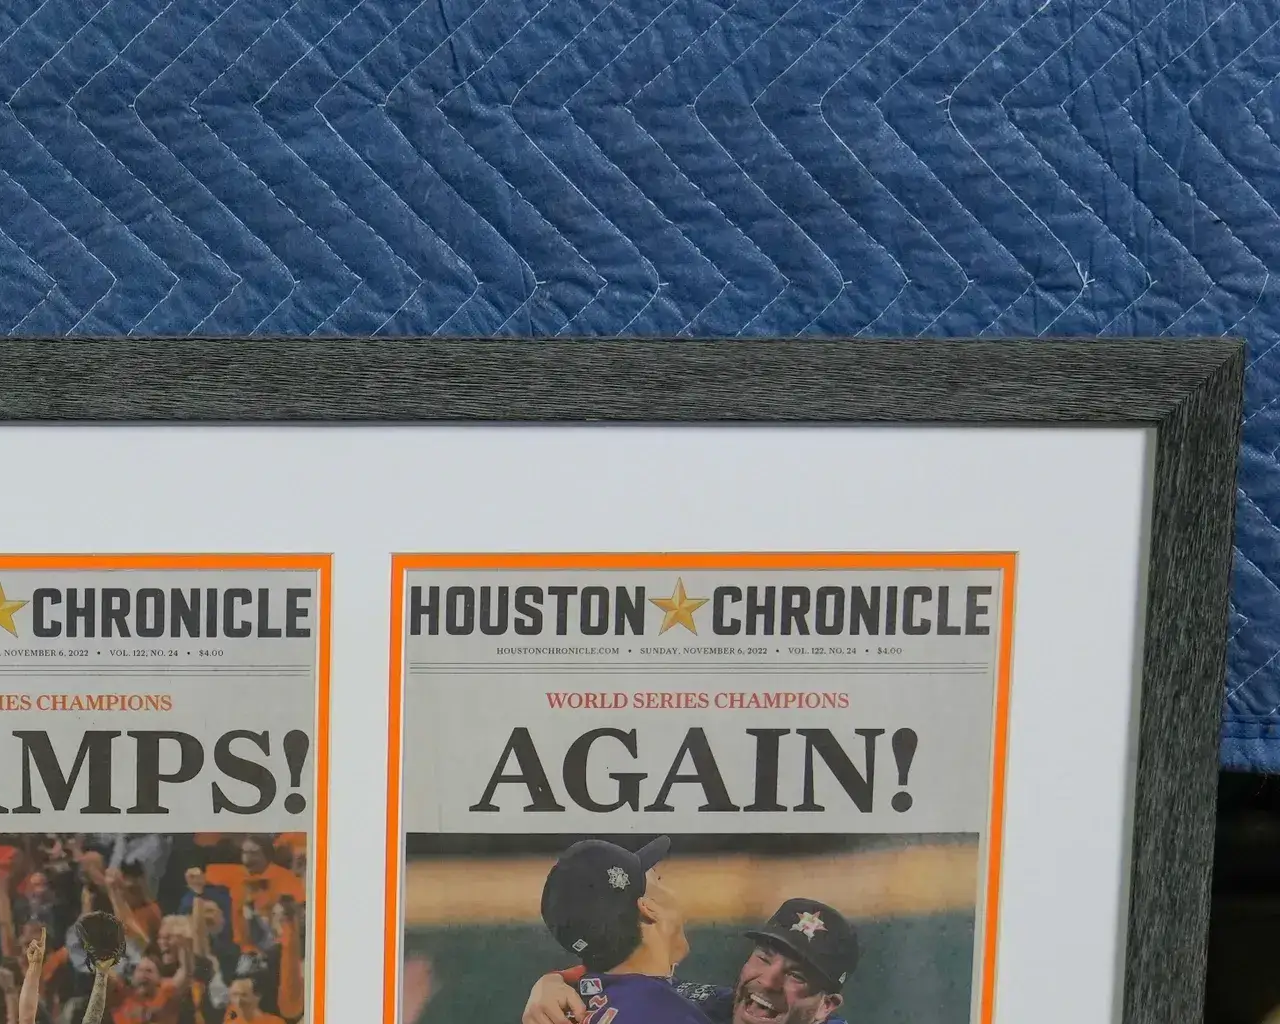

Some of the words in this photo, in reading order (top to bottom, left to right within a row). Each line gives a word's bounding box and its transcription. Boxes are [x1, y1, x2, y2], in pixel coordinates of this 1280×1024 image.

[32, 588, 312, 638] CHRONICLE
[410, 586, 646, 636] HOUSTON
[712, 586, 992, 636] CHRONICLE
[4, 649, 57, 657] NOVEMBER
[68, 649, 89, 657] 2022
[167, 649, 179, 657] 24
[198, 649, 224, 658] $4.00
[496, 647, 620, 655] HOUSTONCHRONICLE.COM
[683, 647, 736, 655] NOVEMBER
[747, 647, 768, 655] 2022
[846, 647, 857, 655] 24
[877, 646, 903, 655] $4.00
[36, 694, 172, 712] CHAMPIONS
[545, 692, 628, 709] WORLD
[633, 692, 710, 709] SERIES
[714, 692, 849, 709] CHAMPIONS
[468, 727, 918, 813] AGAIN!
